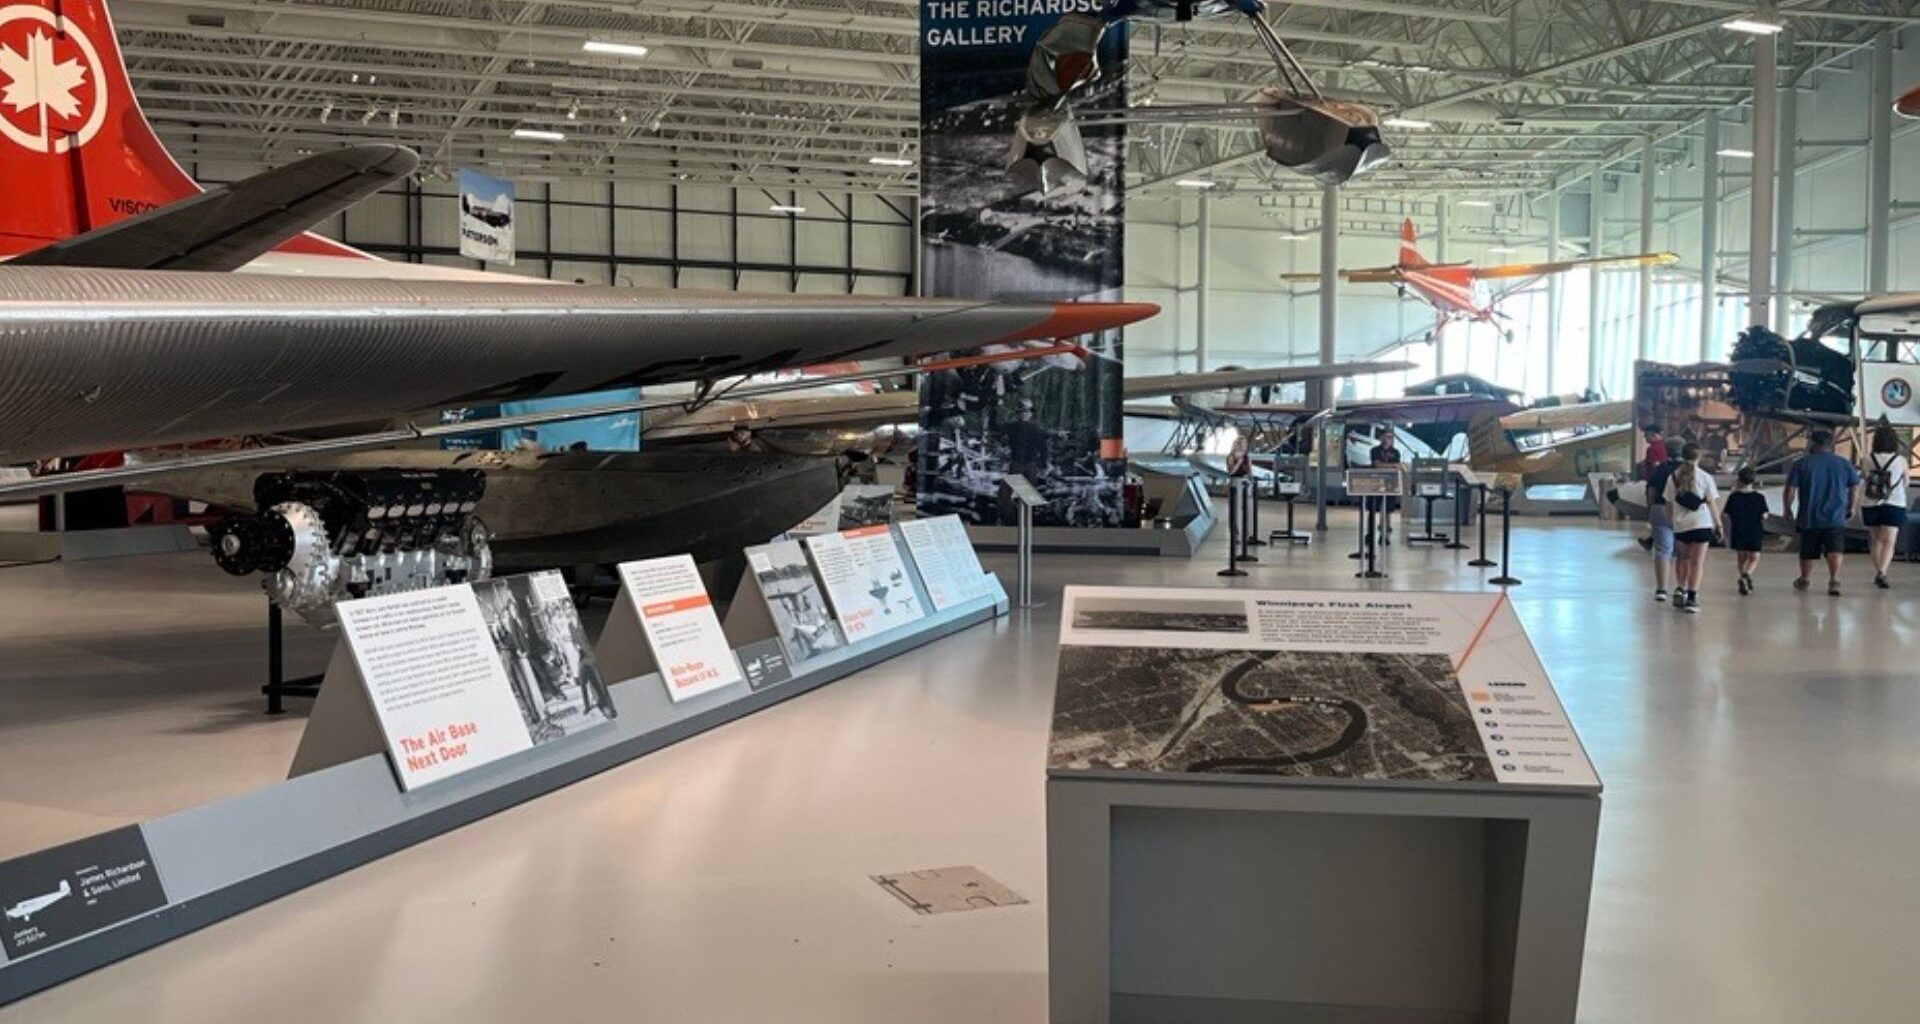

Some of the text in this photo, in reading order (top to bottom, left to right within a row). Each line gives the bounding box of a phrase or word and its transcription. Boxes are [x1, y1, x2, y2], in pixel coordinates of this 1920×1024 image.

[928, 0, 1119, 18] THE RICHARDSO
[927, 25, 1027, 46] GALLERY
[1256, 600, 1413, 610] Winnipeg's First Airport
[400, 721, 477, 753] The Air Base
[407, 744, 468, 771] Next Door
[80, 874, 105, 887] James
[105, 860, 147, 877] Richardson
[113, 873, 141, 889] Limited
